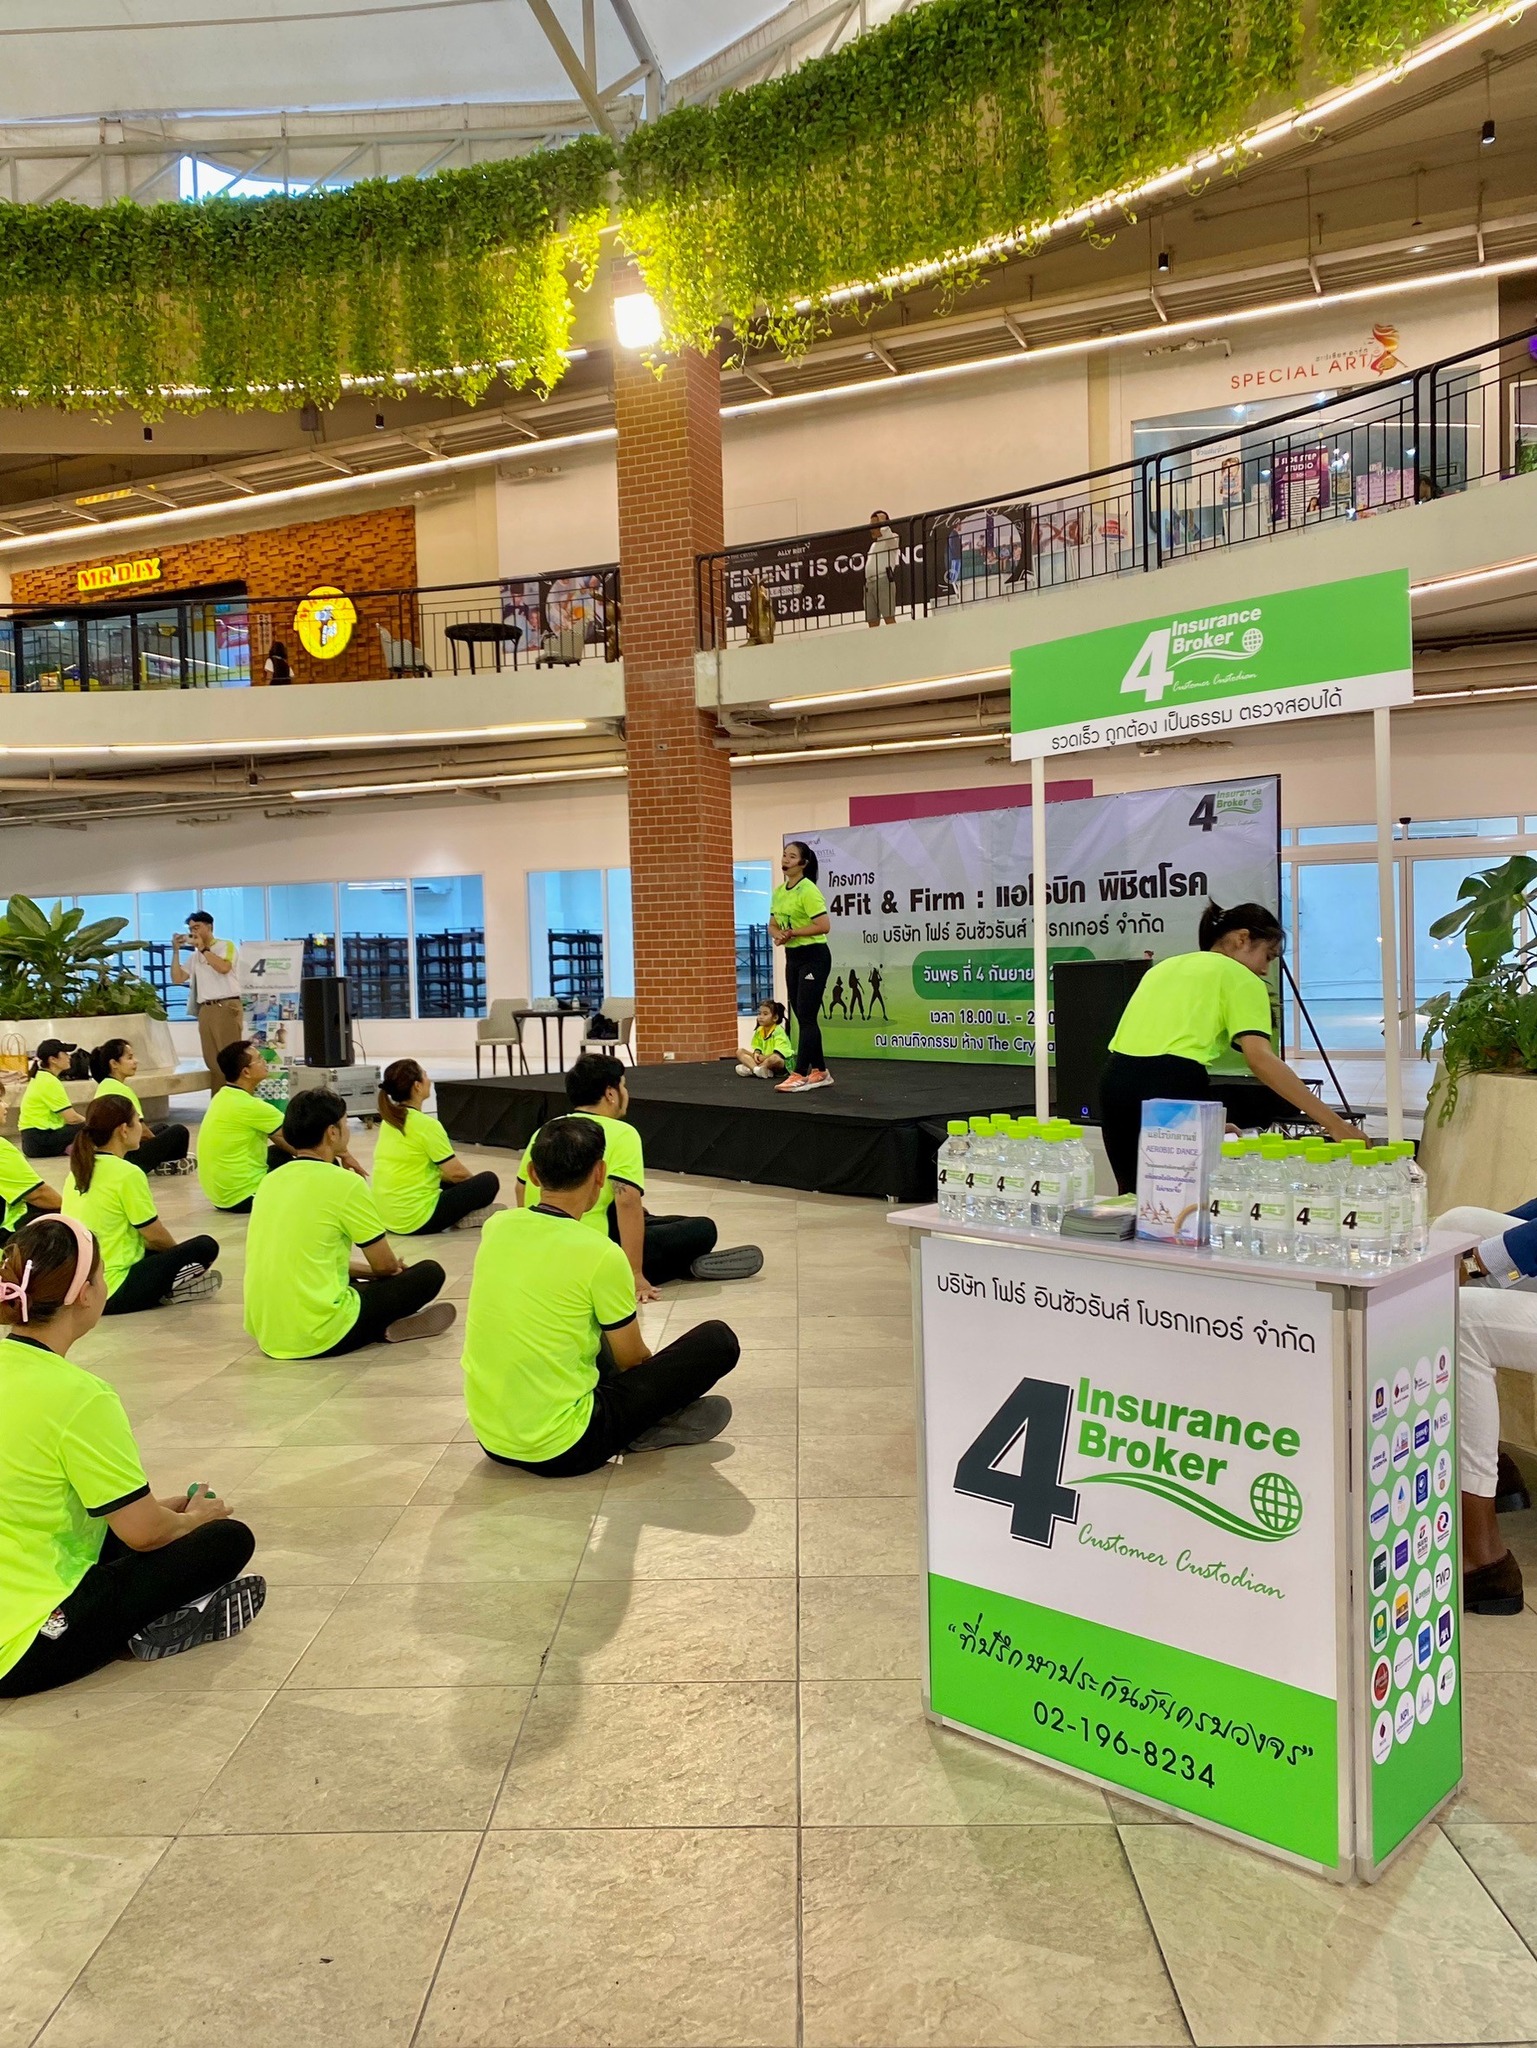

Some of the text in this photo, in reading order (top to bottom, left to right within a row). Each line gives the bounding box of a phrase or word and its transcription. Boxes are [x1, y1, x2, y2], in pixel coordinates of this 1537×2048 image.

[1231, 353, 1369, 389] SPECIAL ART
[777, 549, 791, 557] ALLY
[724, 562, 803, 588] EMENT
[1172, 608, 1262, 637] Insurance
[1172, 631, 1235, 655] Broker
[1120, 627, 1175, 703] 4
[1172, 670, 1258, 692] Customer Custodian
[1051, 687, 1343, 750] รวดเร็ว ถูกต้อง เป็นธรรม ตรวจสอบได้
[1216, 788, 1262, 799] Insurance
[1216, 798, 1249, 808] Broker
[1188, 793, 1219, 832] 4
[828, 870, 875, 887] โครงการ
[830, 892, 872, 917] 4Fit
[881, 889, 899, 915] &
[909, 888, 965, 912] Firm
[977, 890, 984, 908] :
[1098, 862, 1208, 902] พิชิตโรค
[863, 930, 878, 944] โดย
[883, 925, 921, 943] บริษัท
[925, 921, 950, 942] โฟร์
[956, 917, 1028, 941] อินชัวรันส์
[1116, 911, 1165, 935] จำกัด
[250, 958, 267, 977] 4
[923, 965, 959, 988] วันพุธ
[963, 959, 973, 982] ที่
[975, 966, 985, 982] 4
[989, 964, 1035, 982] กันยาย
[930, 1010, 956, 1025] เวลา
[960, 1009, 993, 1025] 18.00
[997, 1011, 1011, 1025] น.
[891, 1033, 958, 1049] ลานกิจกรรม
[962, 1033, 984, 1050] ห้าง
[987, 1036, 1010, 1051] The
[1145, 1145, 1199, 1156] AEROBIC DANCE
[938, 1169, 948, 1184] 4
[965, 1172, 975, 1189] 4
[996, 1175, 1006, 1192] 4
[1030, 1180, 1041, 1197] 4
[1209, 1199, 1221, 1217] 4
[1250, 1203, 1262, 1221] 4
[1296, 1207, 1311, 1226] 4
[1342, 1210, 1358, 1230] 4
[937, 1273, 1317, 1354] บริษัท โฟร์ อินชัวรันส์ โบรกเกอร์ จำกัด
[1076, 1376, 1301, 1458] Insurance
[953, 1376, 1081, 1550] 4
[1077, 1419, 1228, 1486] Broker
[1078, 1523, 1286, 1600] Customer Custodian
[1435, 1567, 1451, 1588] FWD
[1032, 1700, 1217, 1790] 02-196-8234
